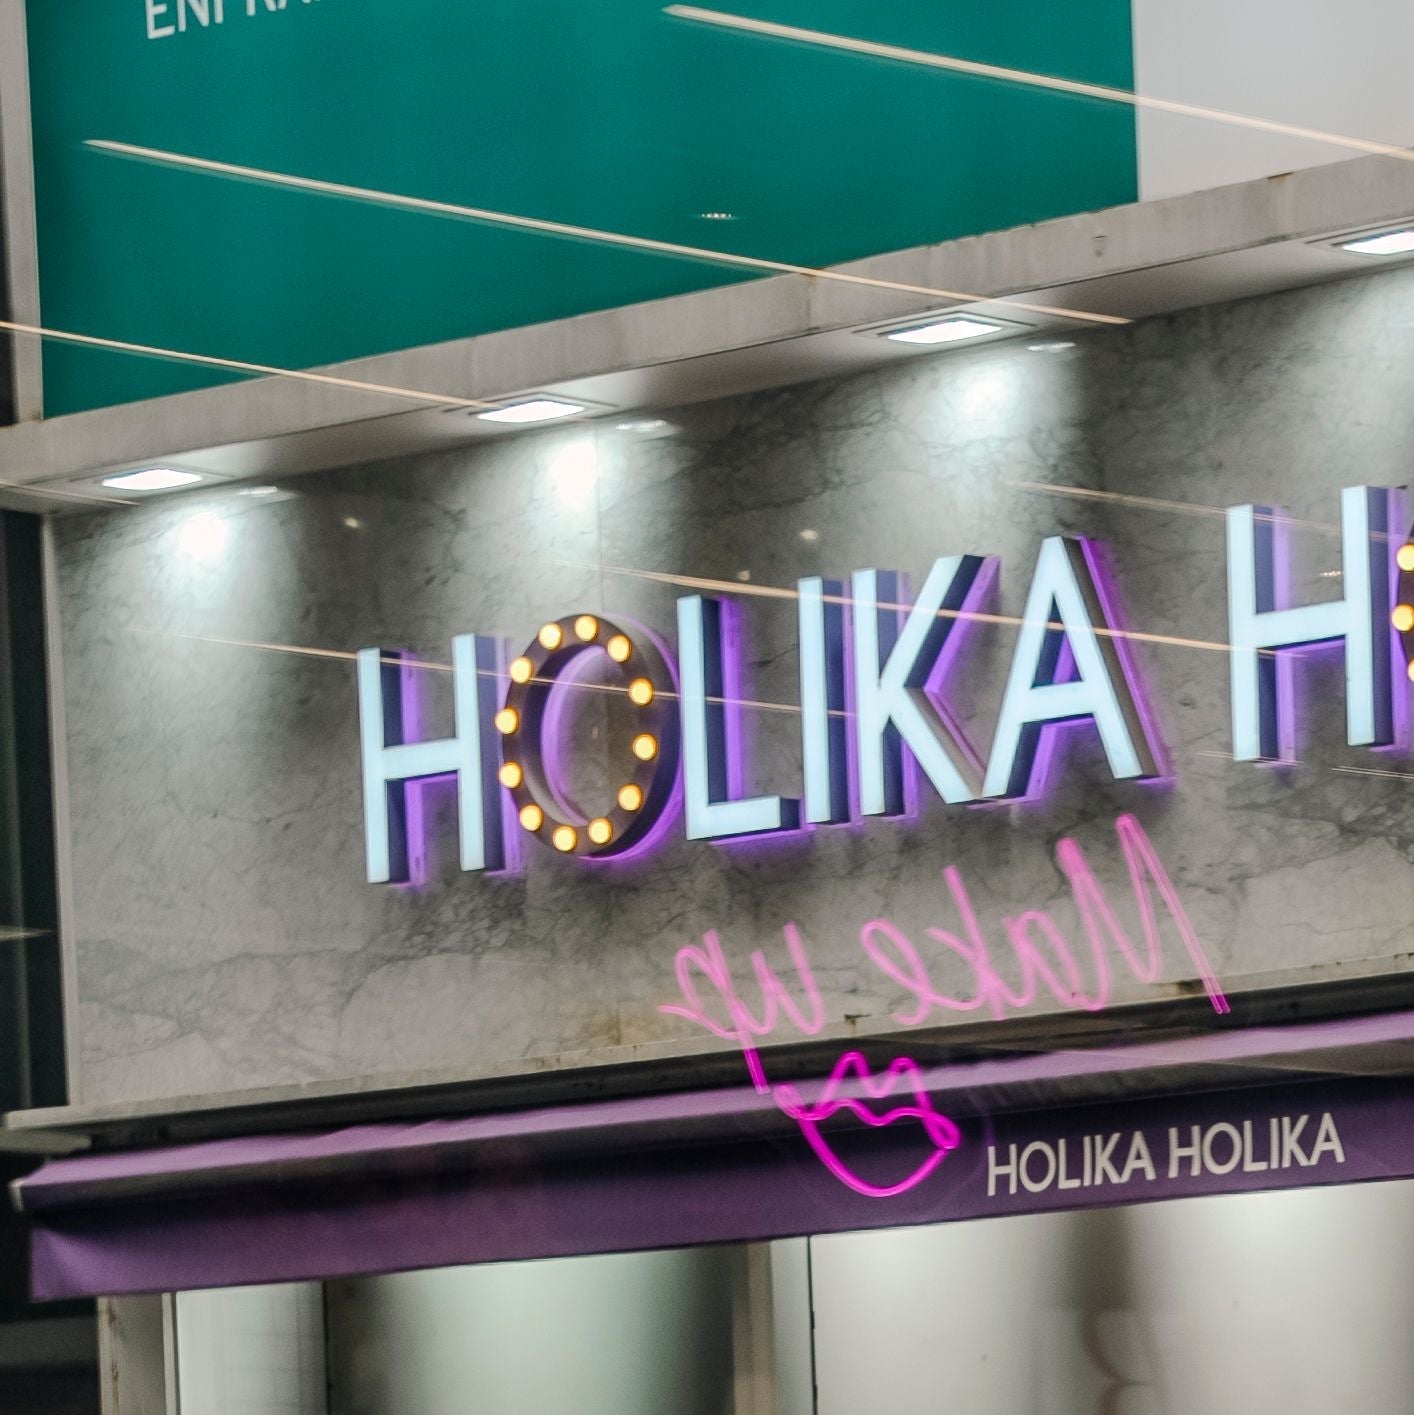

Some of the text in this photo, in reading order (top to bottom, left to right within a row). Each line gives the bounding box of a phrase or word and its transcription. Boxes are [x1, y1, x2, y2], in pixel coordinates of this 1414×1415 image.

[357, 535, 1170, 886] HOLIKA
[986, 1112, 1346, 1197] HOLIKA HOLIKA
